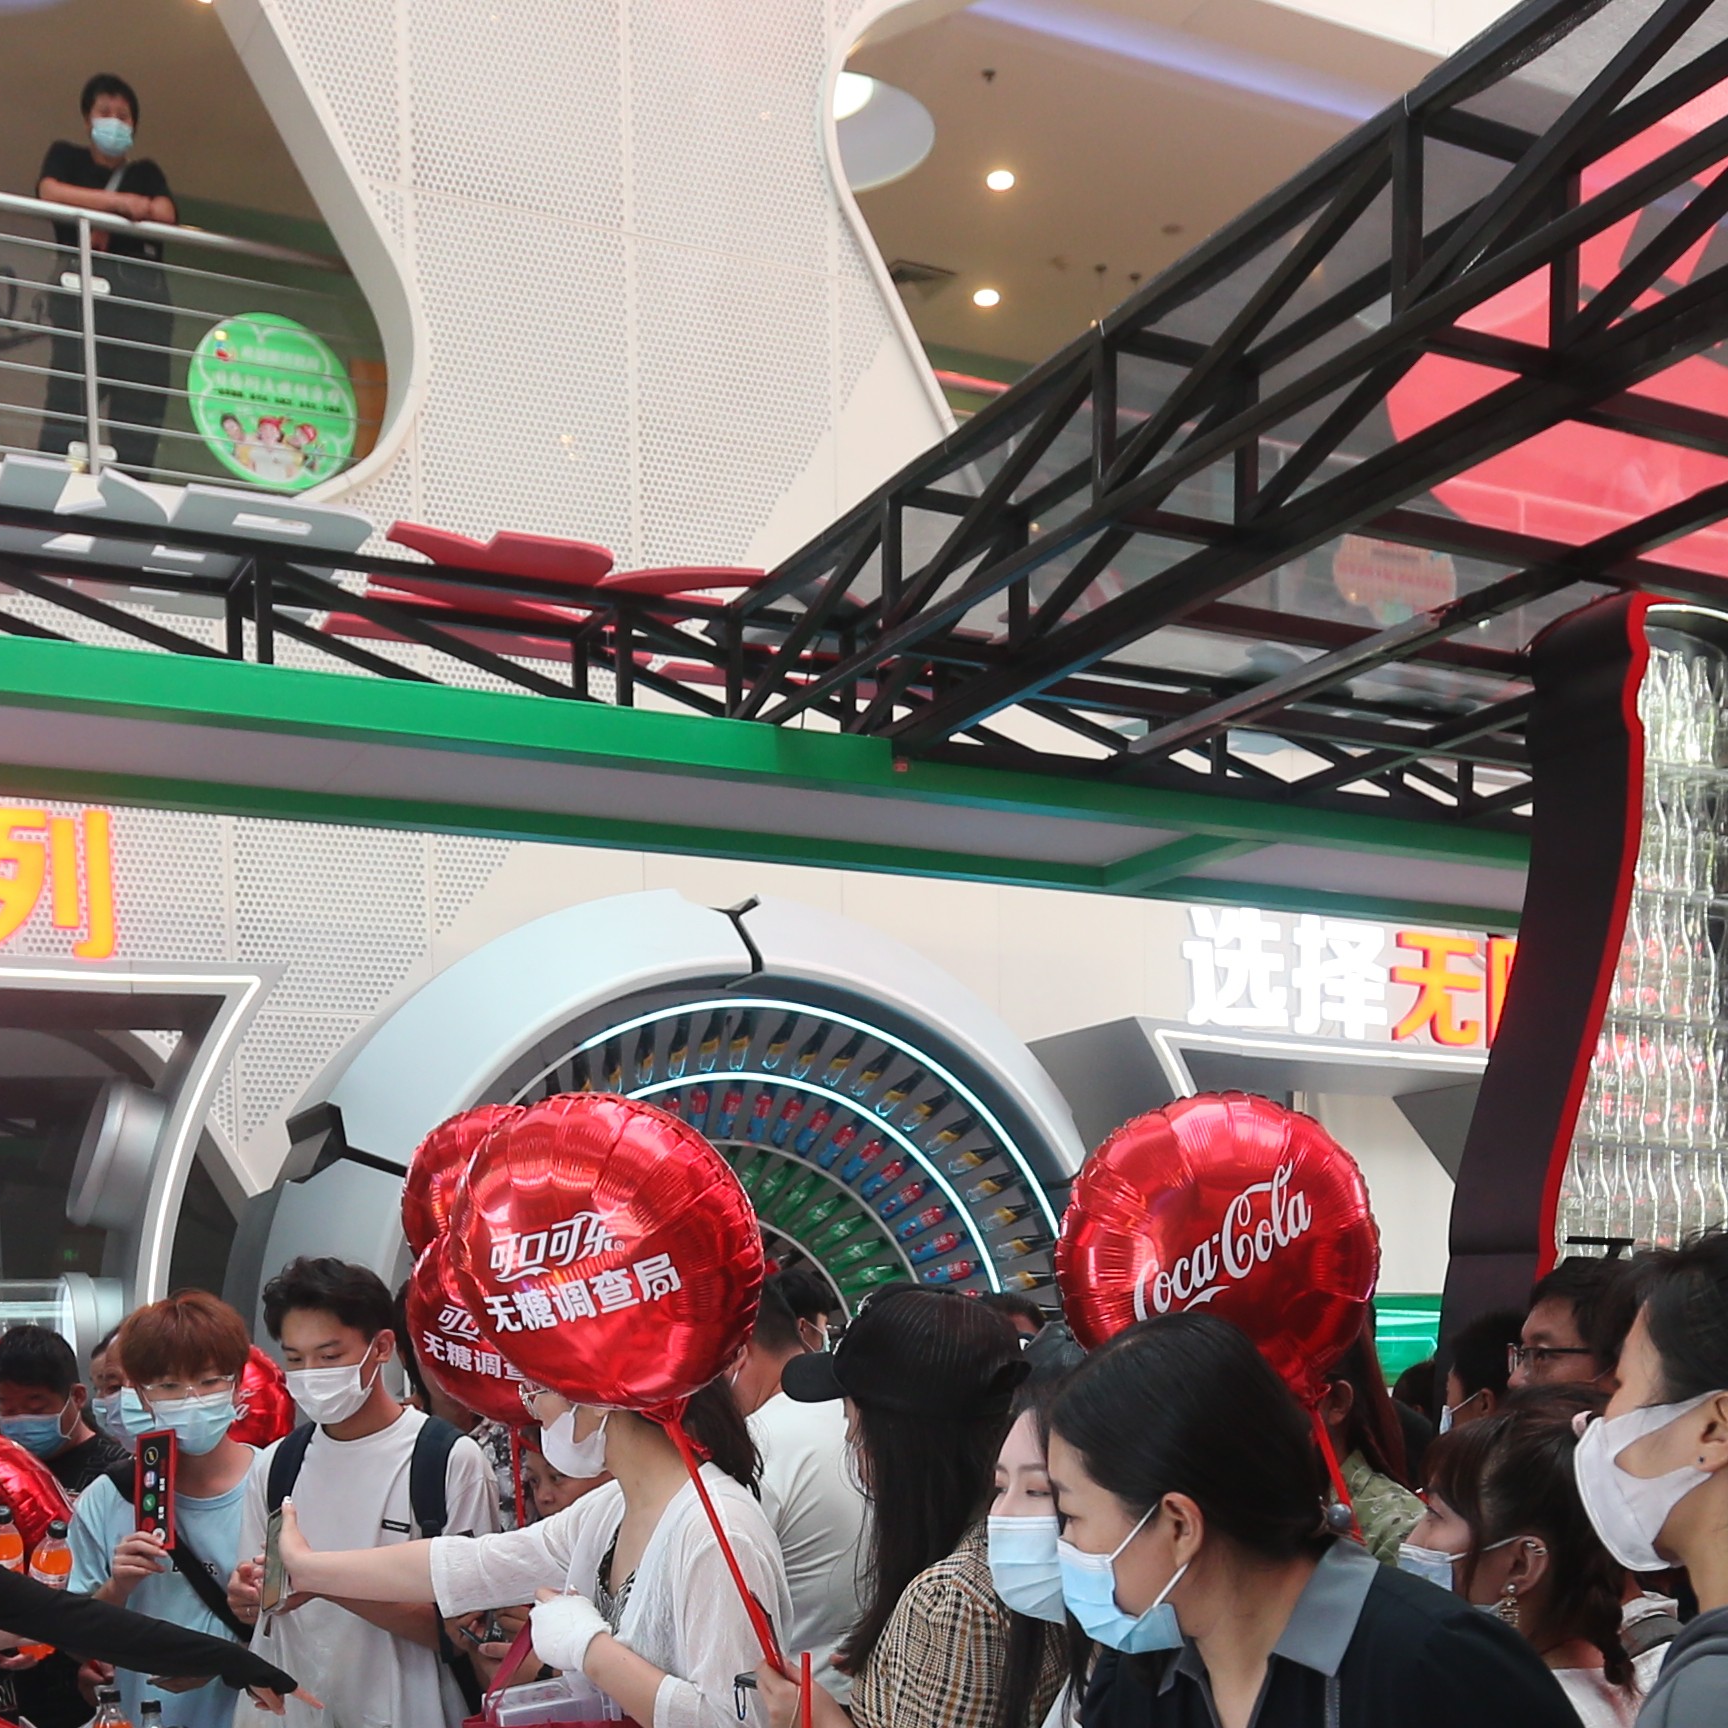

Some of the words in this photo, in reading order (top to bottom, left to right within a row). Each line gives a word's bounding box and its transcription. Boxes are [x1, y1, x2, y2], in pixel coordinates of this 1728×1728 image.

[488, 1210, 617, 1284] 可口可乐
[1133, 1159, 1312, 1324] Coca-Cola
[483, 1252, 682, 1335] 无糖调查局
